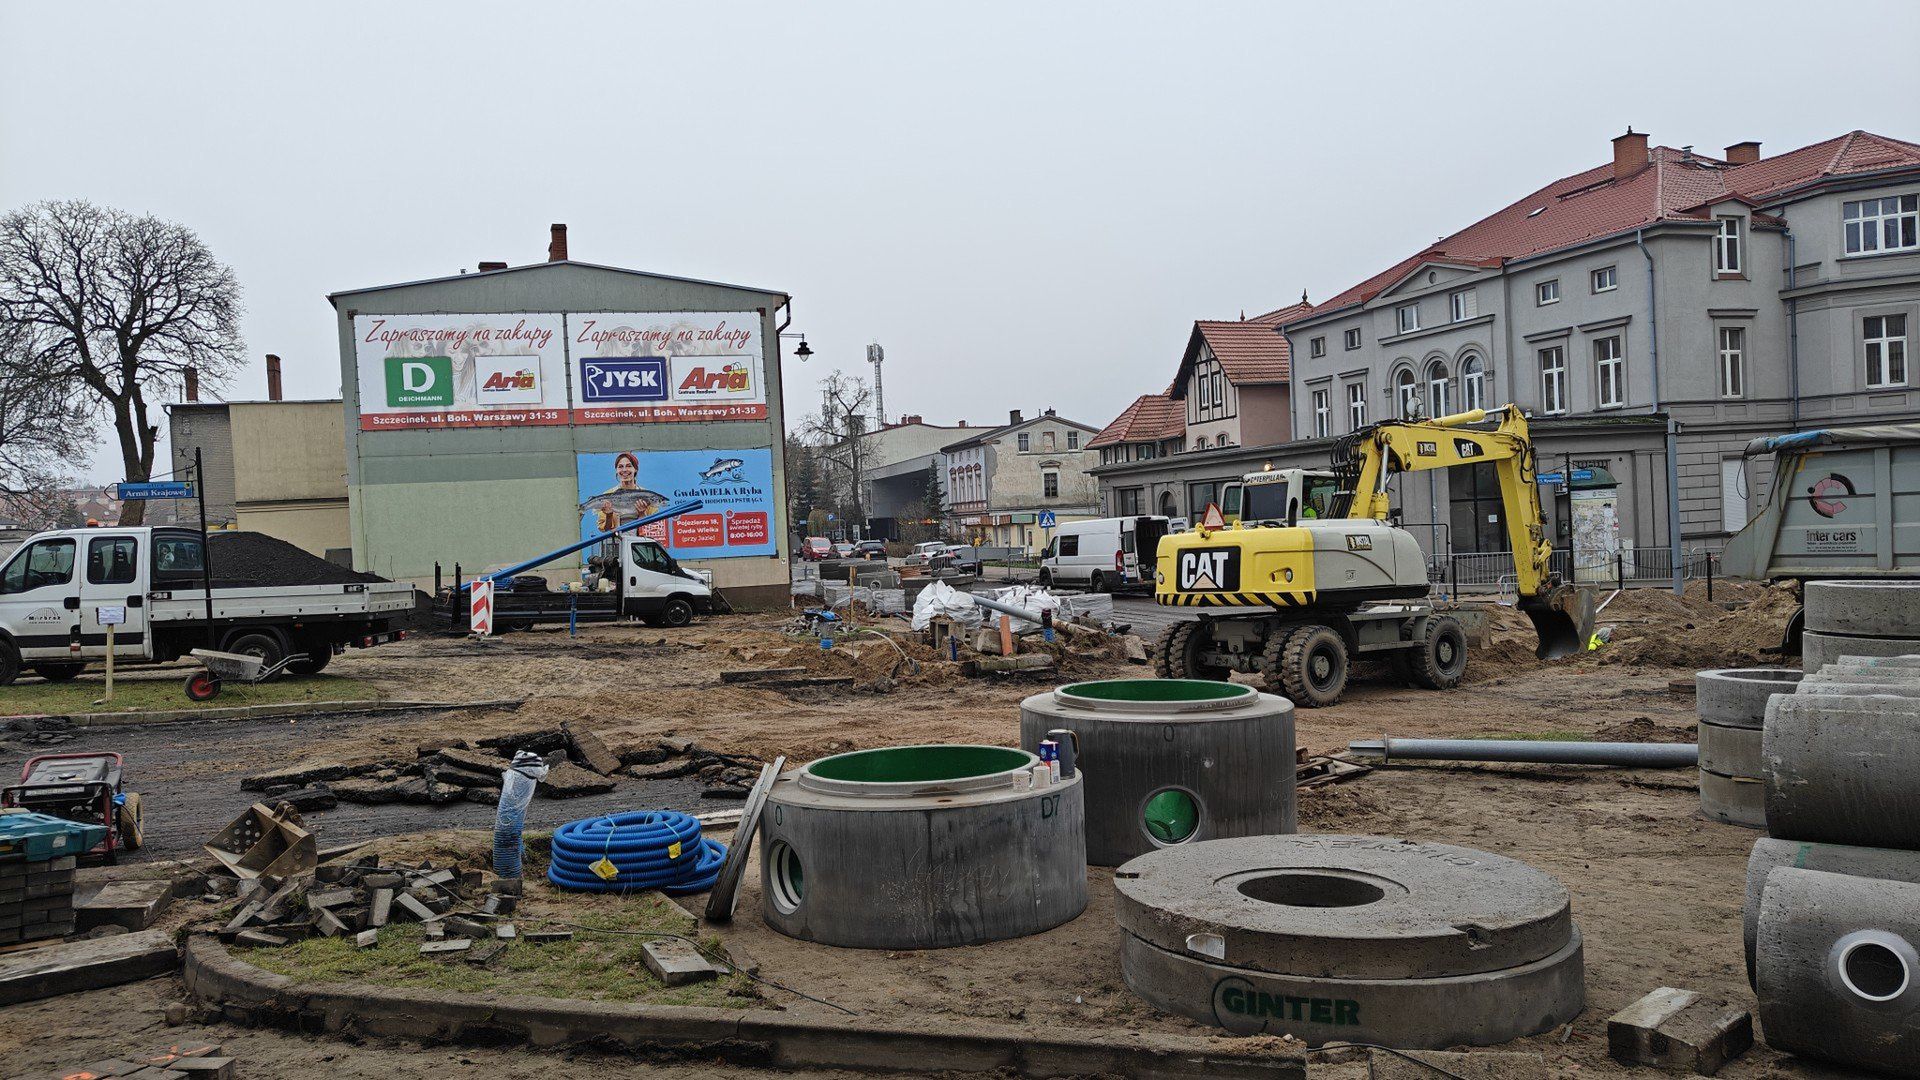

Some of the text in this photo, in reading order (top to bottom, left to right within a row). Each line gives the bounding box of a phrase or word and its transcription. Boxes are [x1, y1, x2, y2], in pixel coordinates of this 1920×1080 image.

[366, 320, 553, 349] Zapraszamy na zakupy
[577, 321, 751, 350] Zapraszamy na zakupy
[402, 362, 436, 392] D
[482, 370, 536, 389] Aria
[602, 370, 658, 388] JYSK
[679, 365, 748, 390] Aria
[373, 415, 429, 424] Szczecinek,
[447, 413, 471, 422] Boh.
[474, 412, 526, 422] Warszawy
[529, 411, 558, 420] 31-35
[584, 406, 757, 419] Szczecinek, ul. Boh. Warszawy 31-35
[1461, 442, 1474, 457] CAT
[151, 489, 186, 497] Krajowej
[1806, 530, 1857, 541] inter cars
[1181, 552, 1229, 589] CAT
[1041, 794, 1061, 820] D7
[1221, 987, 1361, 1026] GINTER
